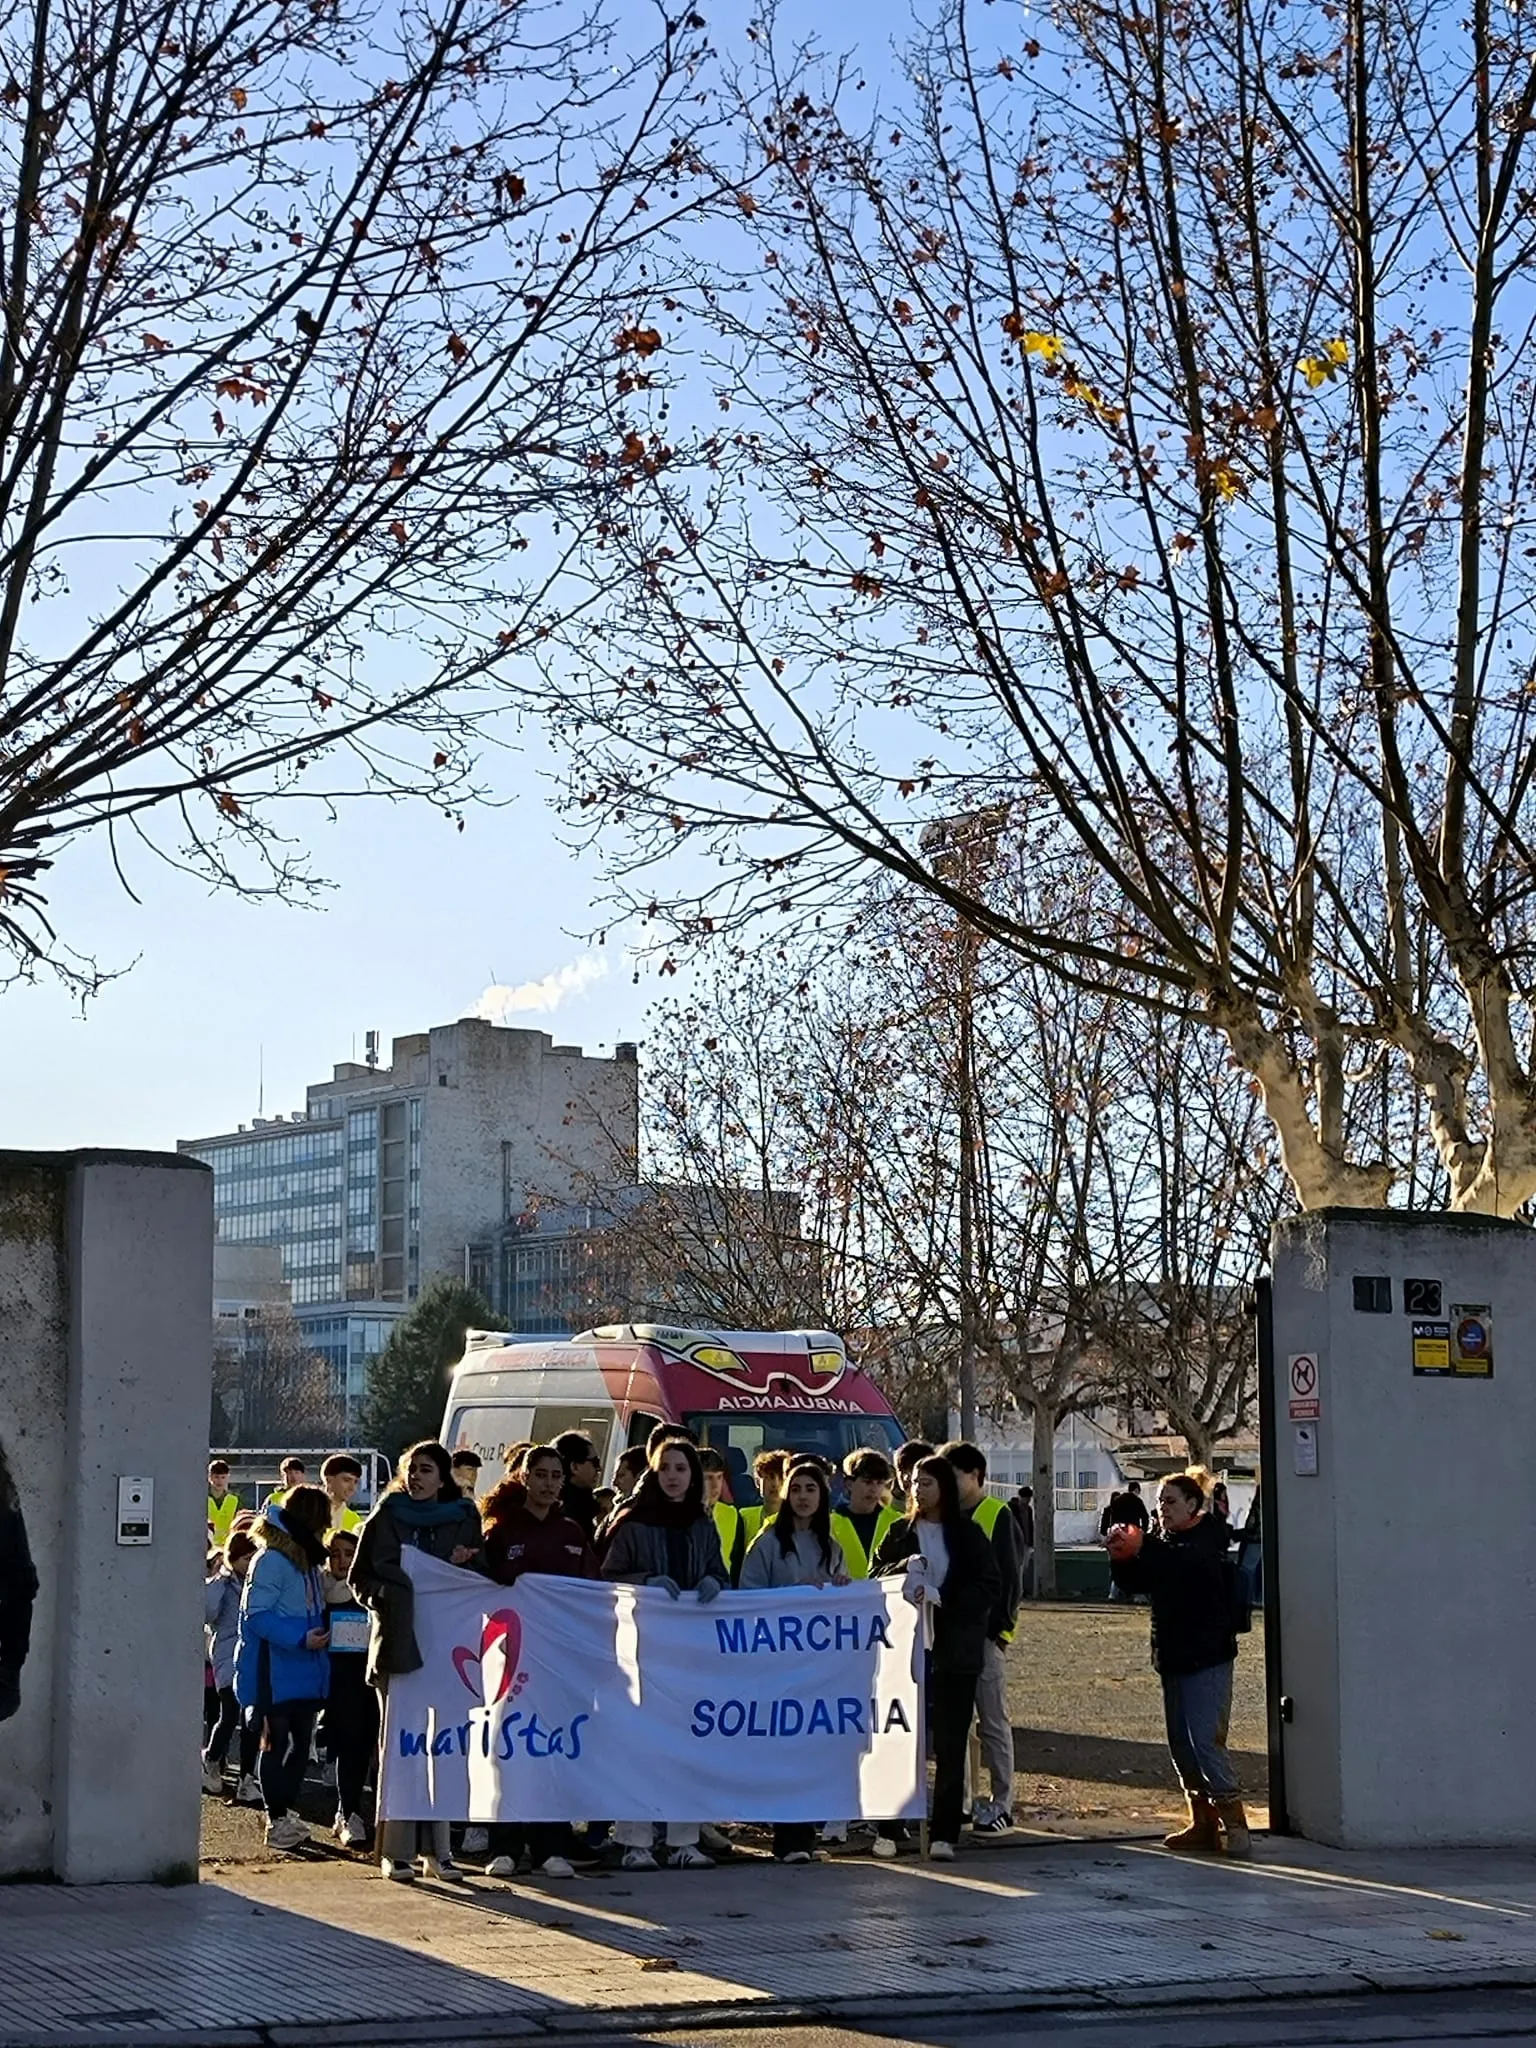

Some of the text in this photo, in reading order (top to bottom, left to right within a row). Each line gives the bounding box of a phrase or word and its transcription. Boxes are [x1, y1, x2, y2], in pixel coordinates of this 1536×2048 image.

[1410, 1281, 1441, 1312] 23
[714, 1614, 893, 1654] MARCHA
[400, 1710, 590, 1760] maristas
[691, 1697, 912, 1738] SOLIDARIA
